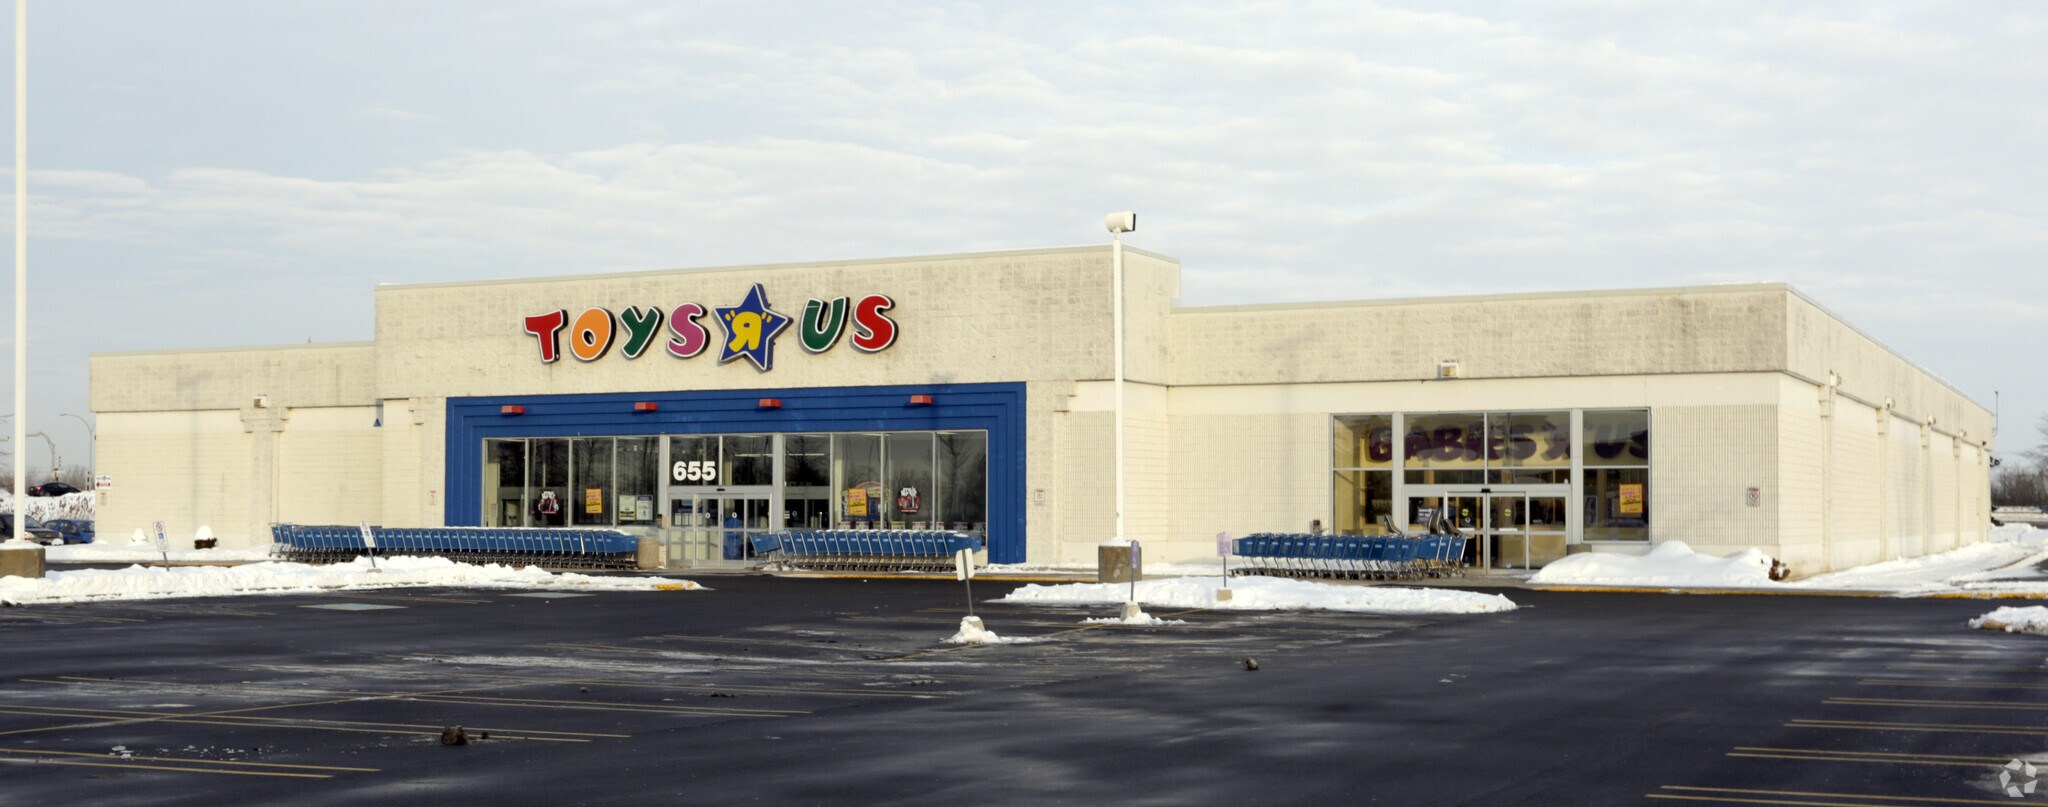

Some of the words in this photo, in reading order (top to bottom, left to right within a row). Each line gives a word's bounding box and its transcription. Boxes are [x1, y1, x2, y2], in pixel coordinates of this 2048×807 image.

[524, 301, 710, 364] TOYS
[799, 294, 899, 354] US
[1367, 422, 1537, 461] BABIES
[673, 460, 716, 481] 655
